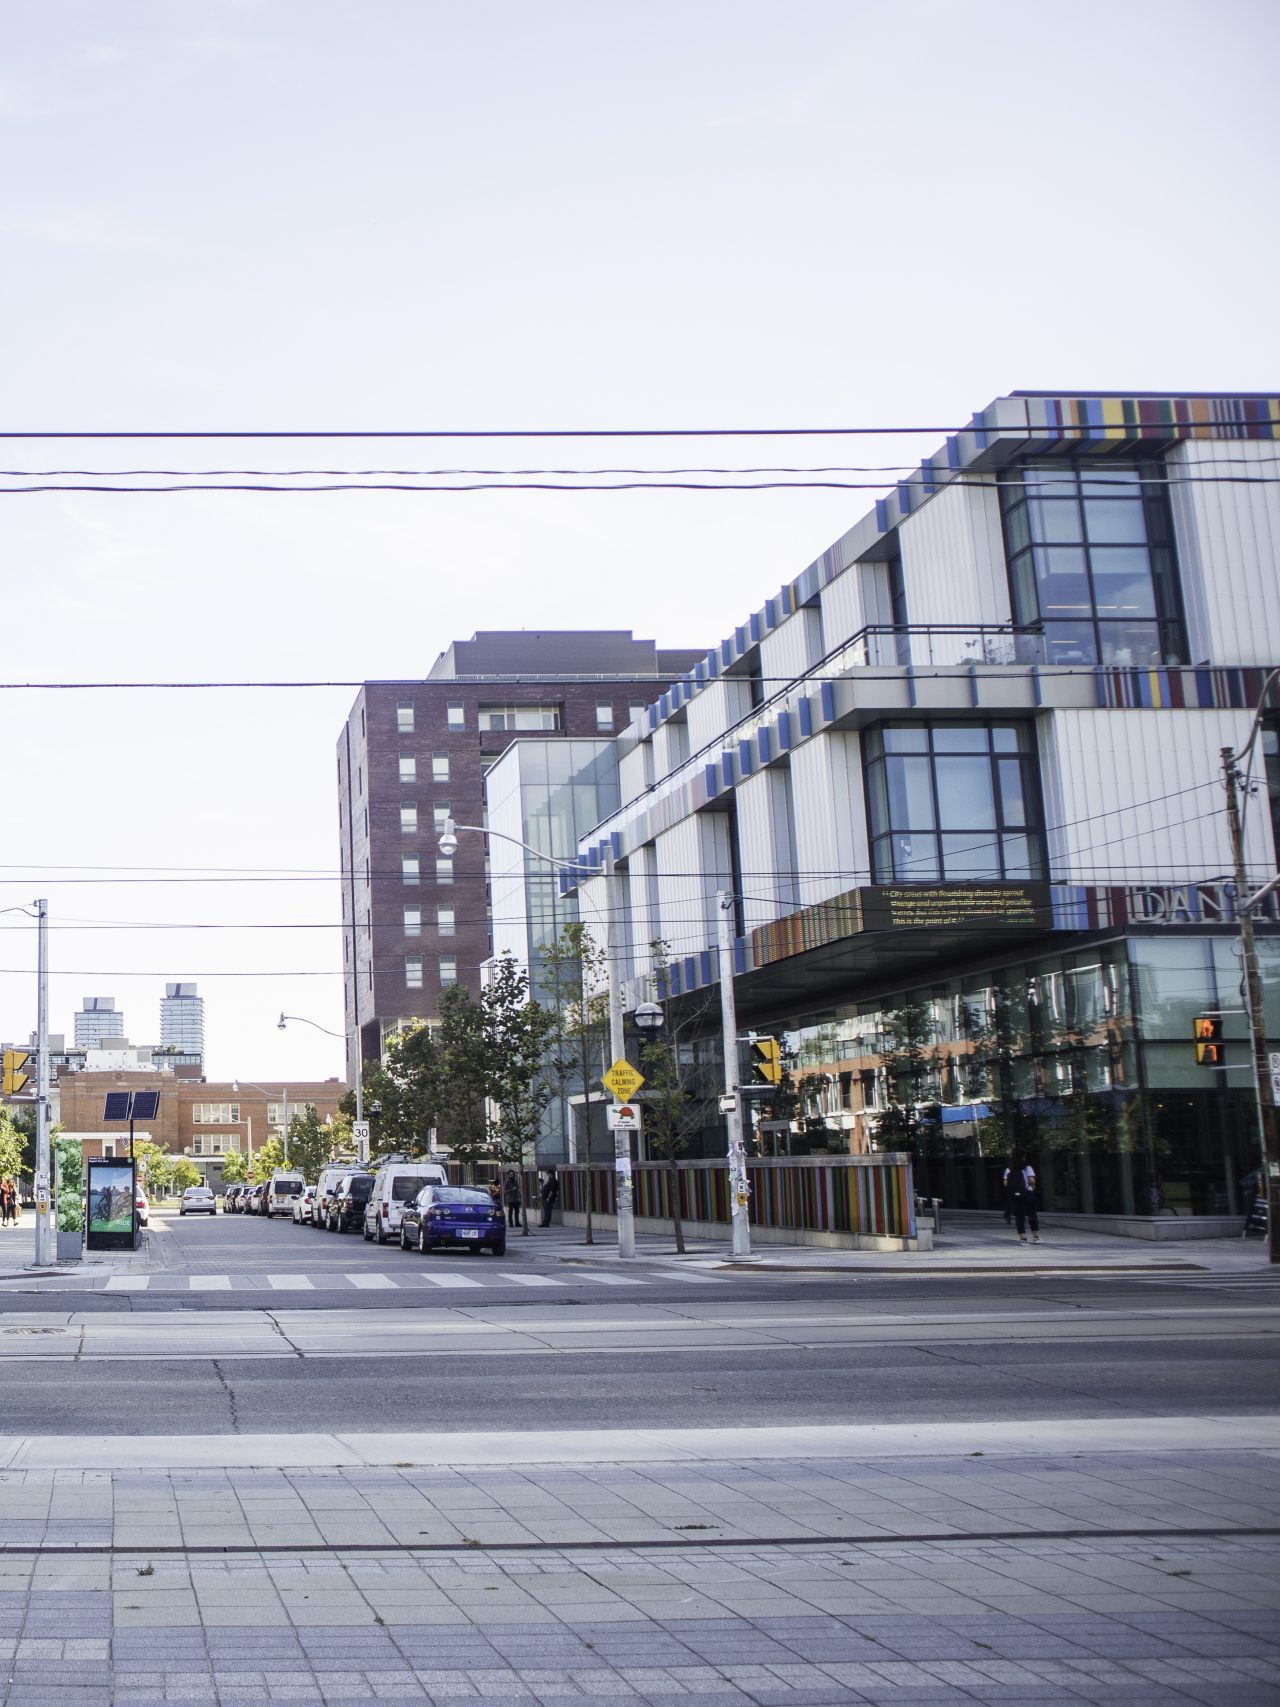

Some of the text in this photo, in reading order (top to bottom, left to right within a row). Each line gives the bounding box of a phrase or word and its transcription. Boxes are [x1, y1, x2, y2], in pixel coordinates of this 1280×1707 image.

[611, 1069, 634, 1077] TRAFFIC
[611, 1078, 635, 1086] CALMING
[617, 1087, 631, 1095] ZONE
[355, 1128, 368, 1138] 30
